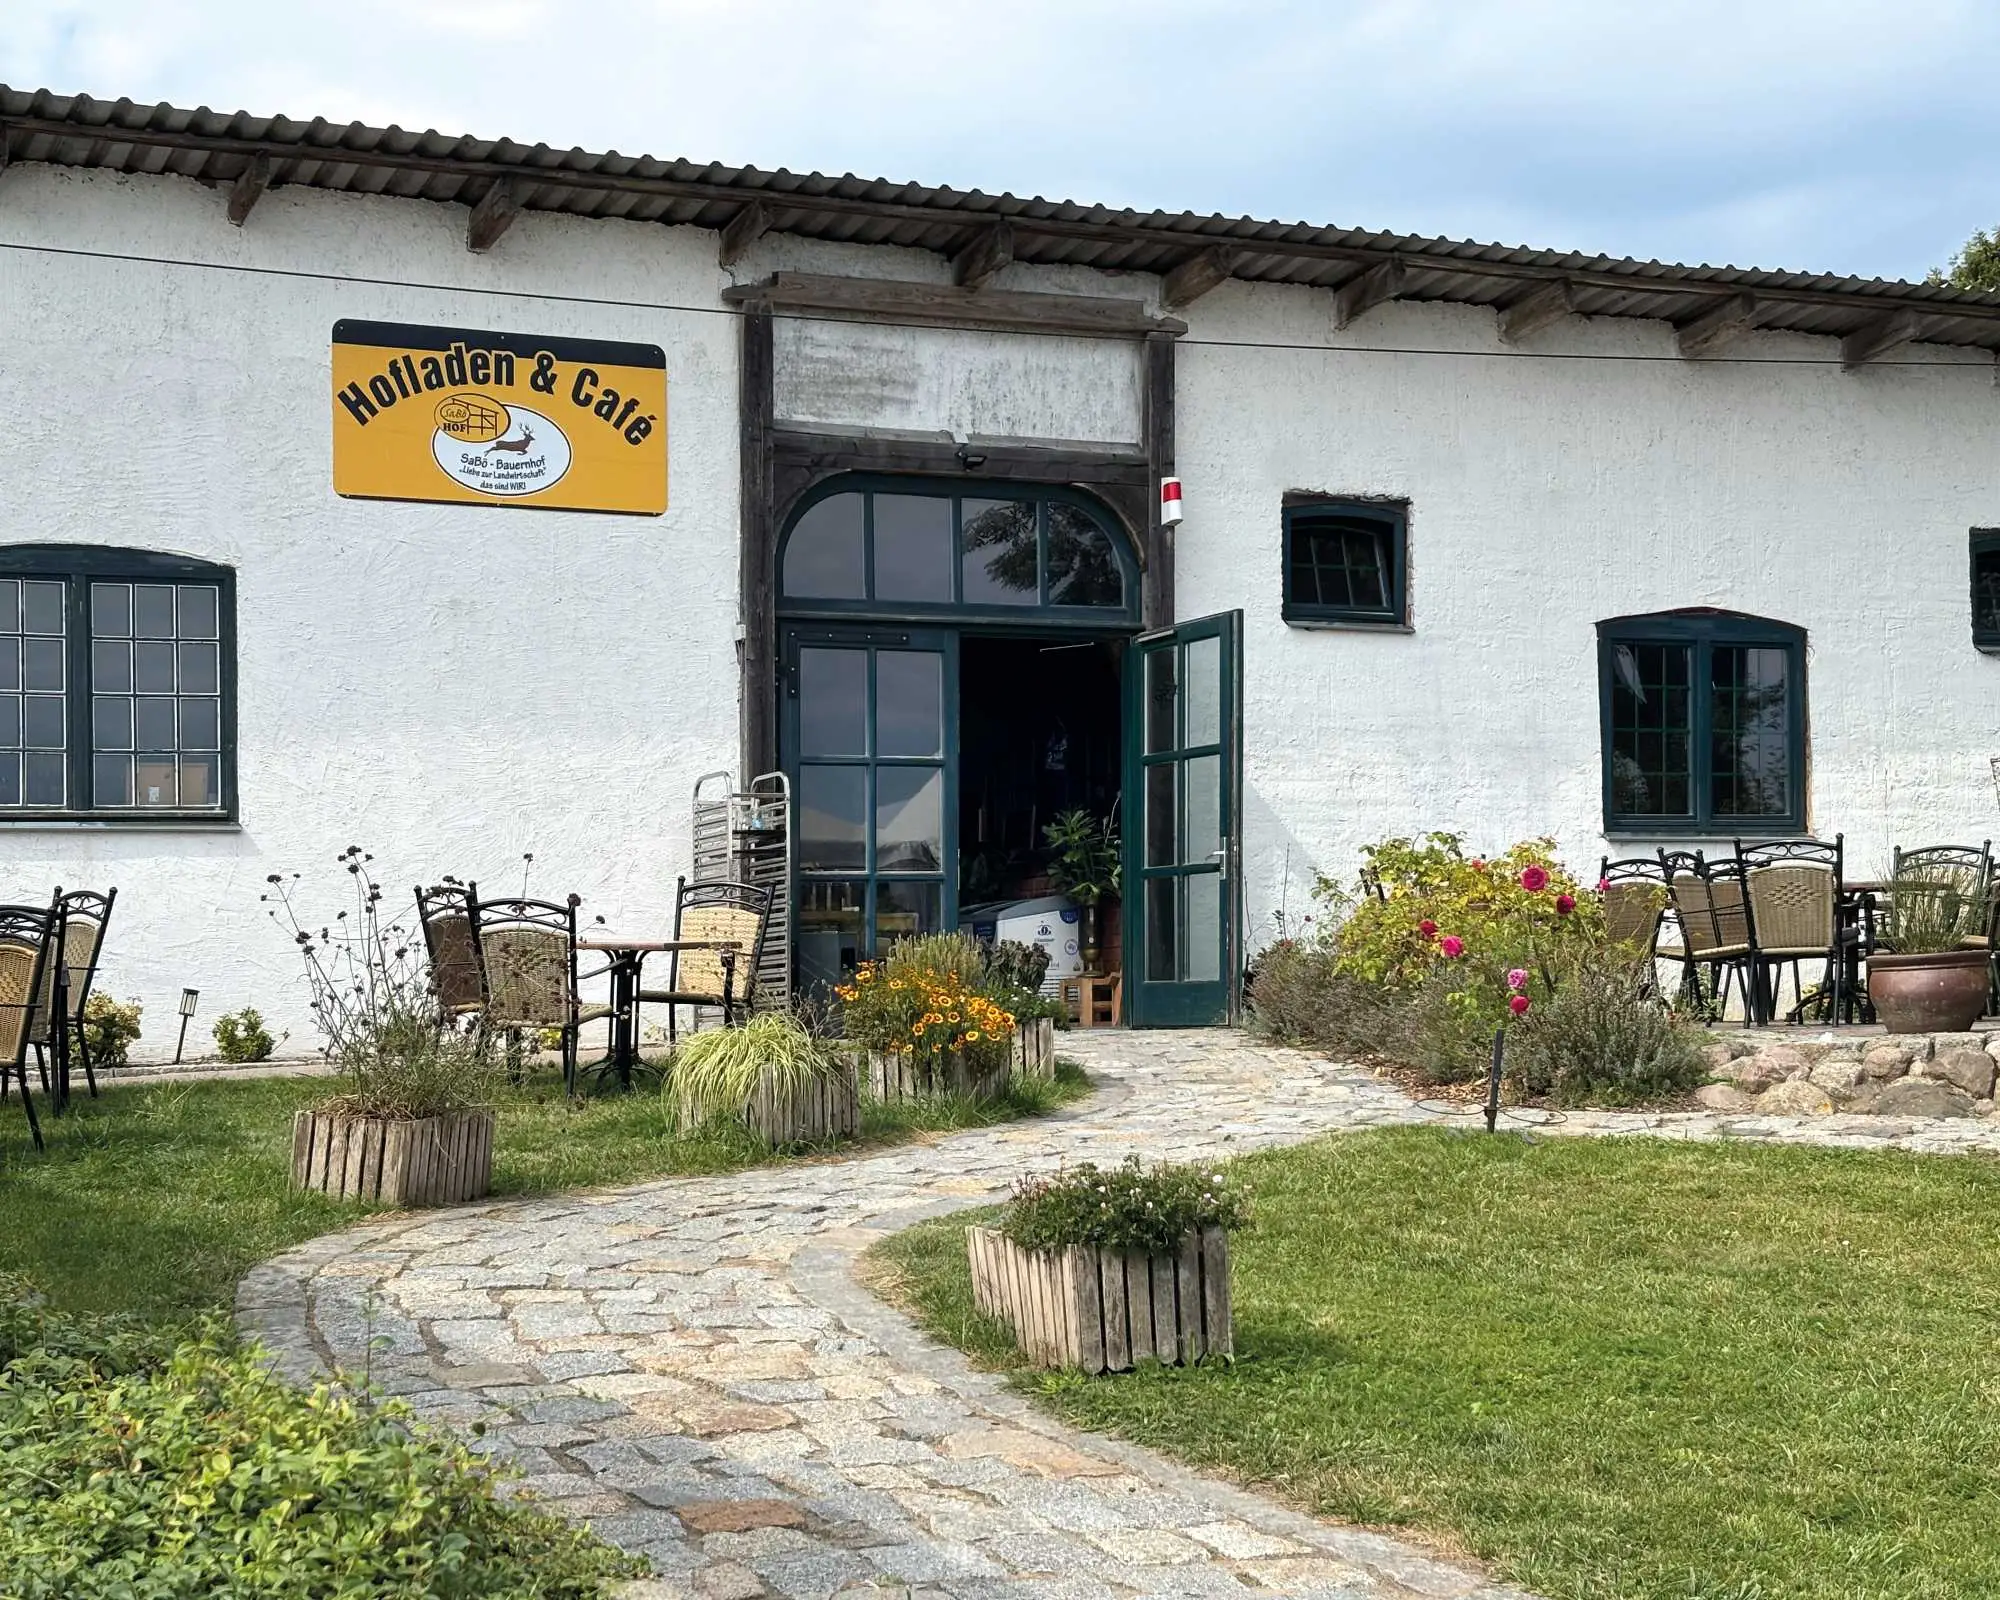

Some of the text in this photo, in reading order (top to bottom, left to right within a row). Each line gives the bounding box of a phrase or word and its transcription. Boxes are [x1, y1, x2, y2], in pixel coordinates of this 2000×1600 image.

[337, 343, 657, 446] Hofladen & Café
[443, 423, 467, 432] HOF
[461, 453, 488, 468] SaBö
[496, 456, 545, 470] Bauernhof
[480, 480, 526, 490] das sind WIR!
